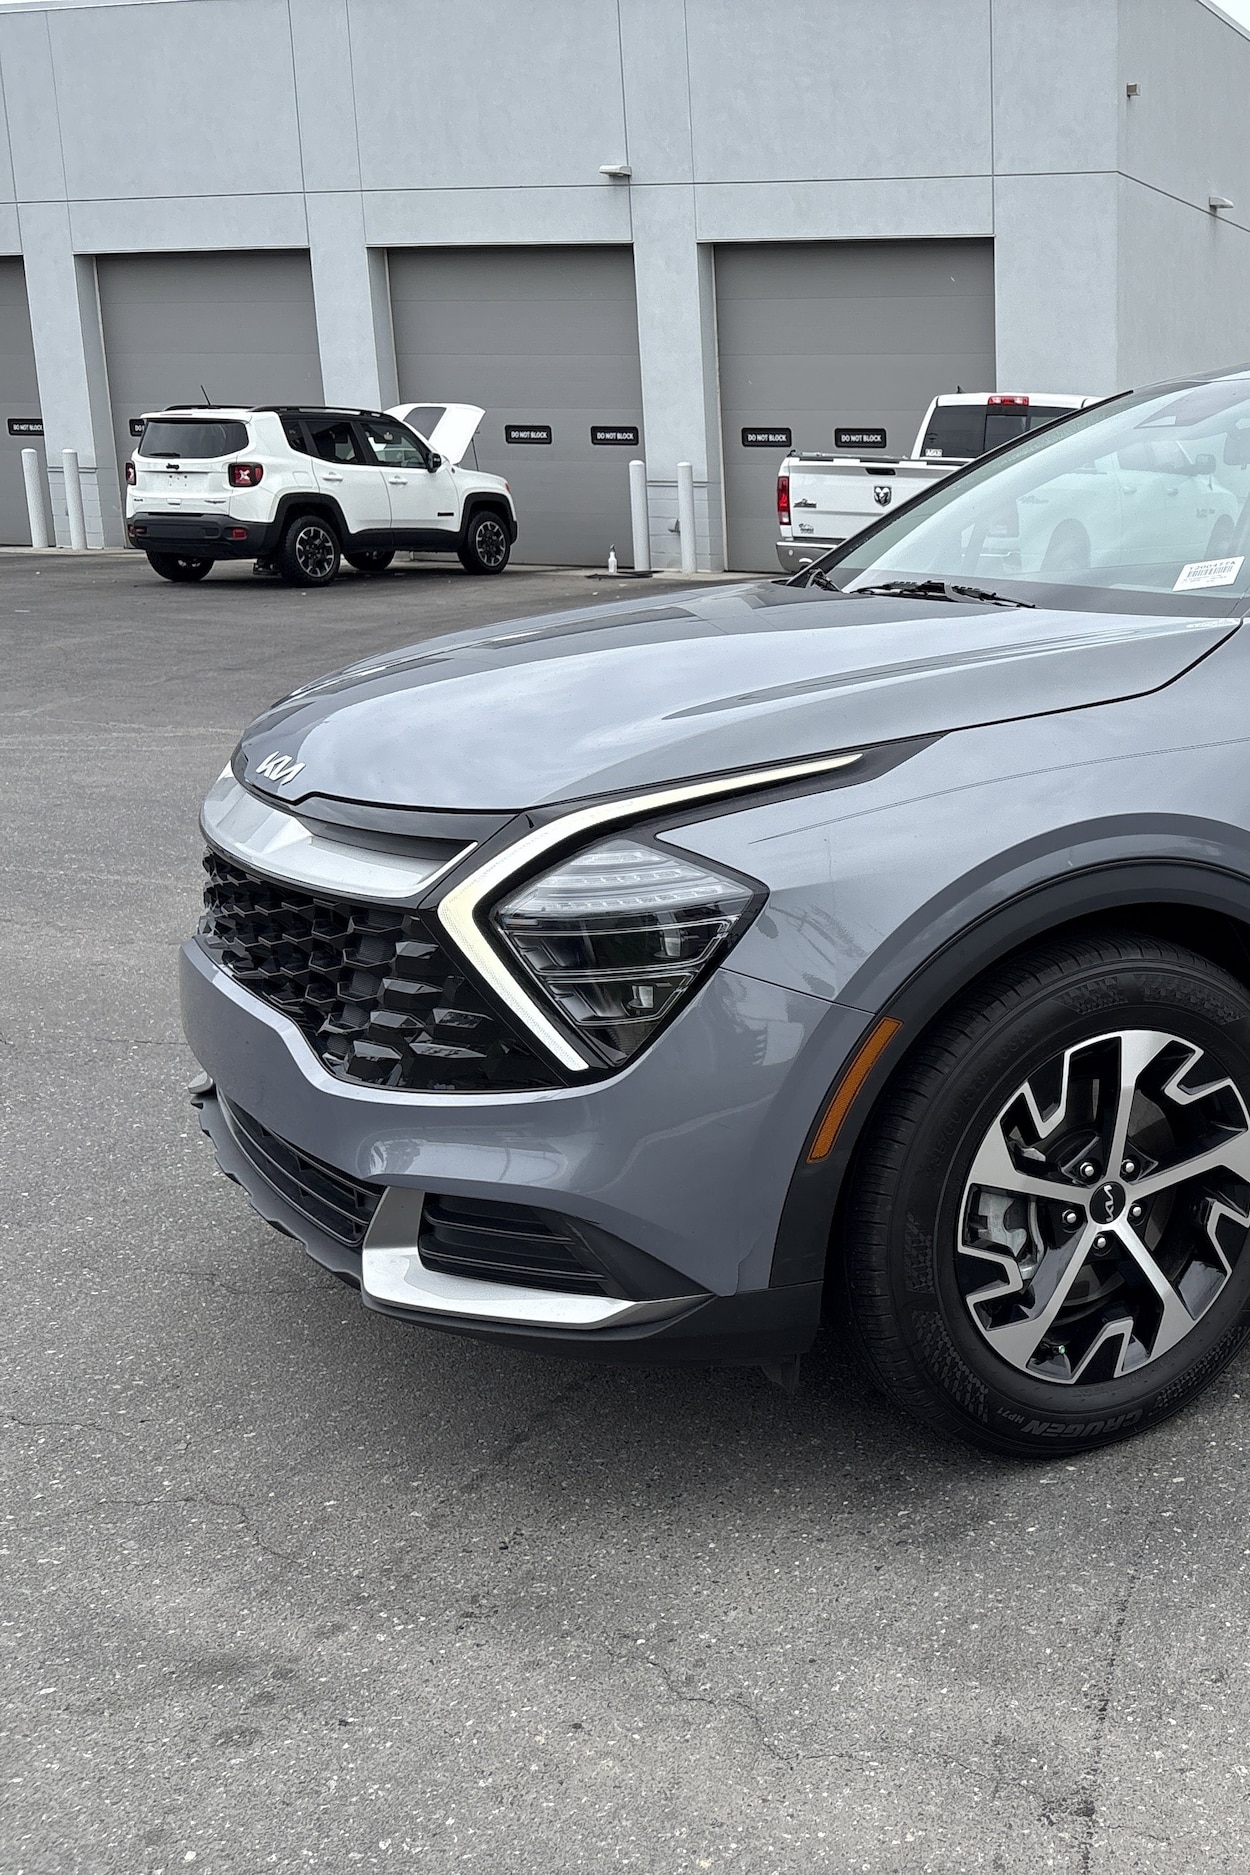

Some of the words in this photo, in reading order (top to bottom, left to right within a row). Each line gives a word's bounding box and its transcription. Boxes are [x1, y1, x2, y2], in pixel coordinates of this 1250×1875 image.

[531, 431, 548, 439] BLOCK
[617, 432, 634, 440] BLOCK
[256, 751, 306, 786] KIA
[997, 1407, 1025, 1424] HP71
[1020, 1409, 1143, 1438] CRUGEN
